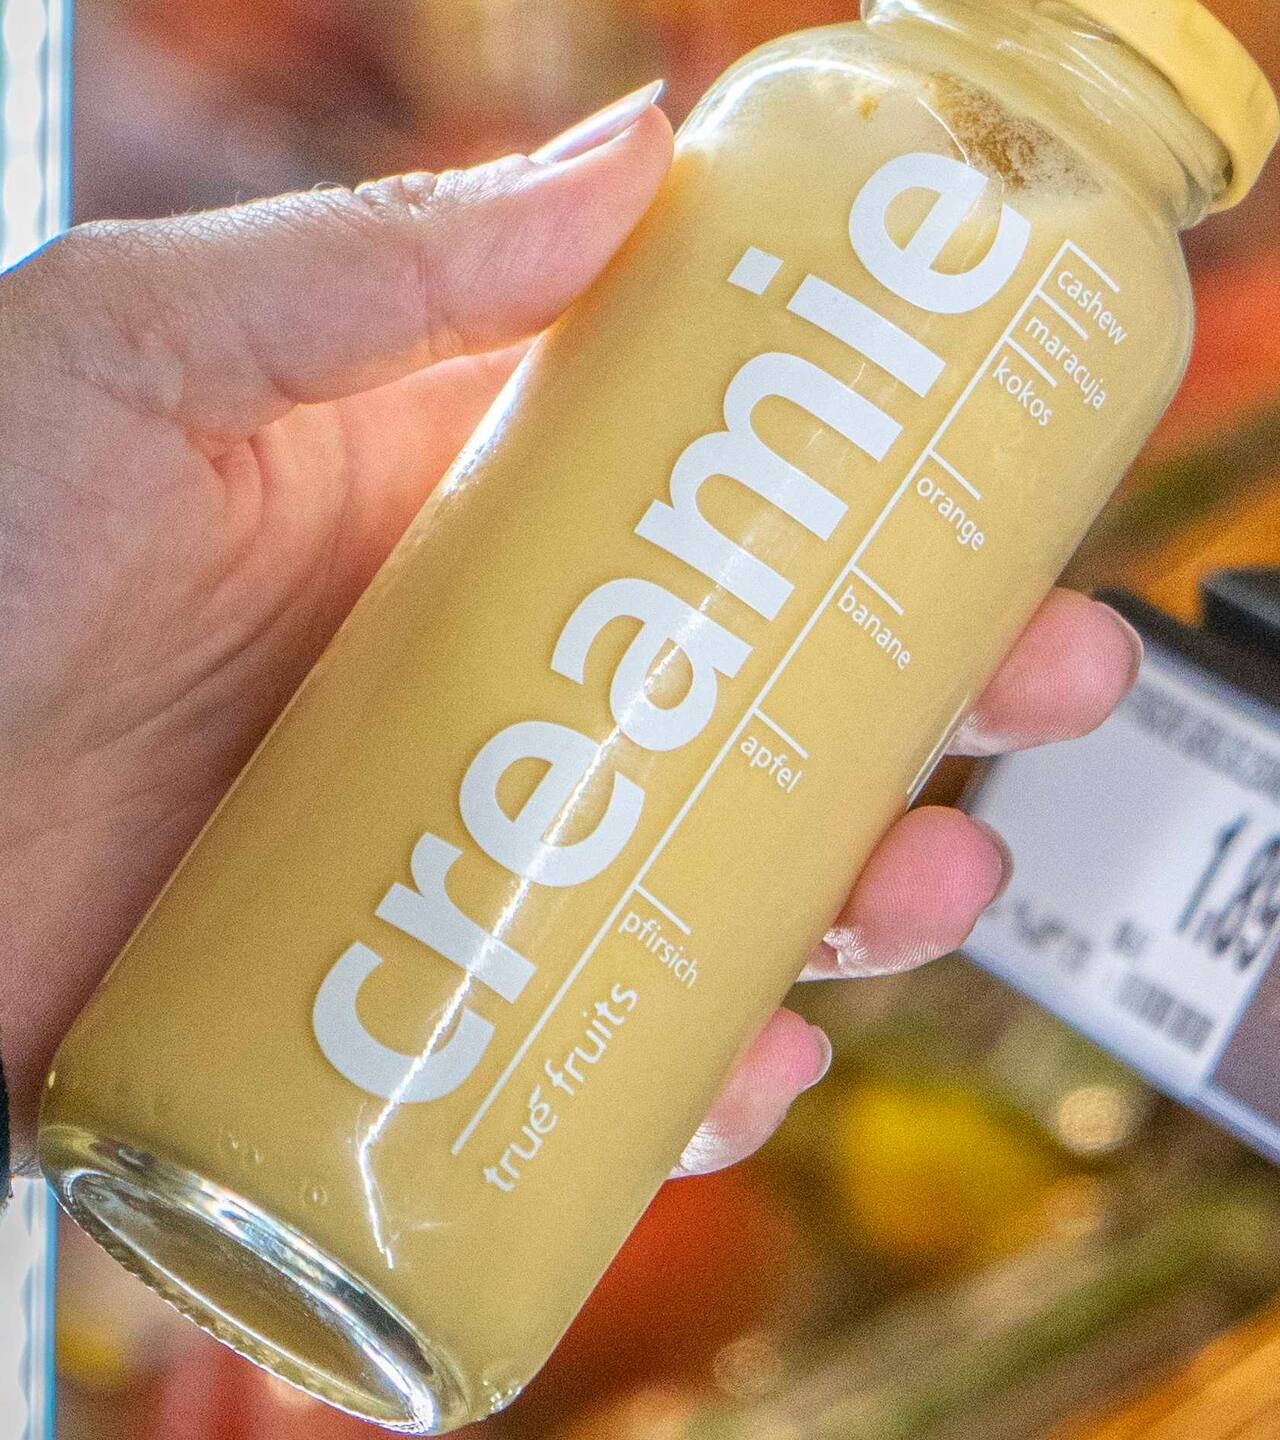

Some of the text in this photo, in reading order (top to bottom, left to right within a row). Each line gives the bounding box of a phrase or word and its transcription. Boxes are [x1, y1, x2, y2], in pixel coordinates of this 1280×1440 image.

[1056, 270, 1128, 346] cashew
[992, 356, 1053, 427] kokos
[1024, 316, 1107, 410] maracuja
[916, 476, 986, 552] orange
[312, 152, 1032, 1104] creamie
[837, 584, 912, 670] banane
[739, 735, 803, 795] apfel
[617, 911, 699, 989] pfirsich
[482, 982, 639, 1193] true fruits
